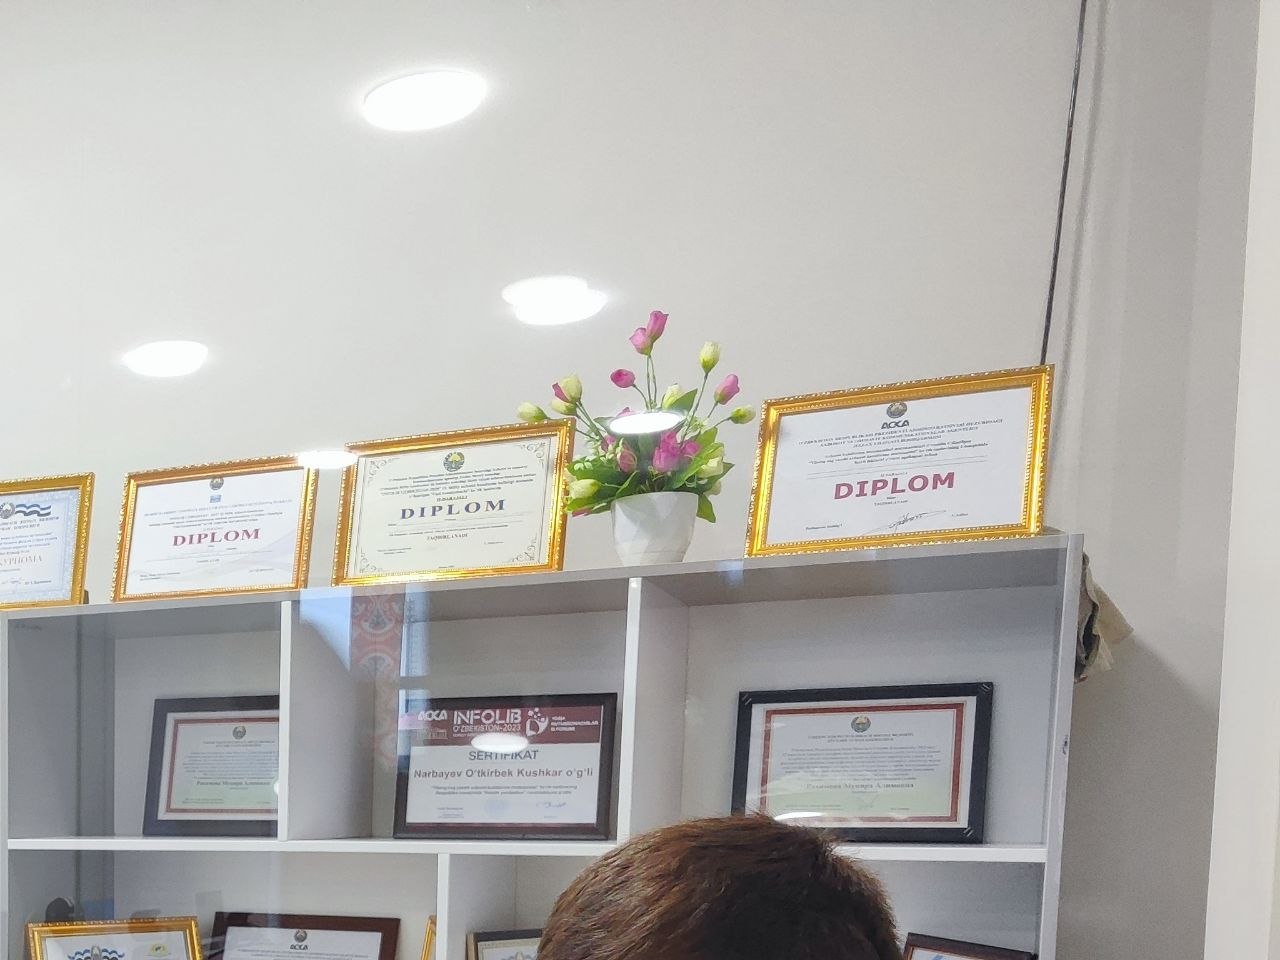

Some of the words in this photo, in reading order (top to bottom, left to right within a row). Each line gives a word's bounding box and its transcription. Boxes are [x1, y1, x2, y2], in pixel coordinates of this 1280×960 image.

[834, 471, 956, 500] DIPLOM
[400, 499, 506, 519] DIPLOM
[173, 528, 261, 547] DIPLOM
[453, 708, 522, 724] INFOLIB
[468, 750, 539, 761] SERTIFIKAT
[413, 769, 462, 779] Narbayev
[517, 767, 562, 777] Kushkar
